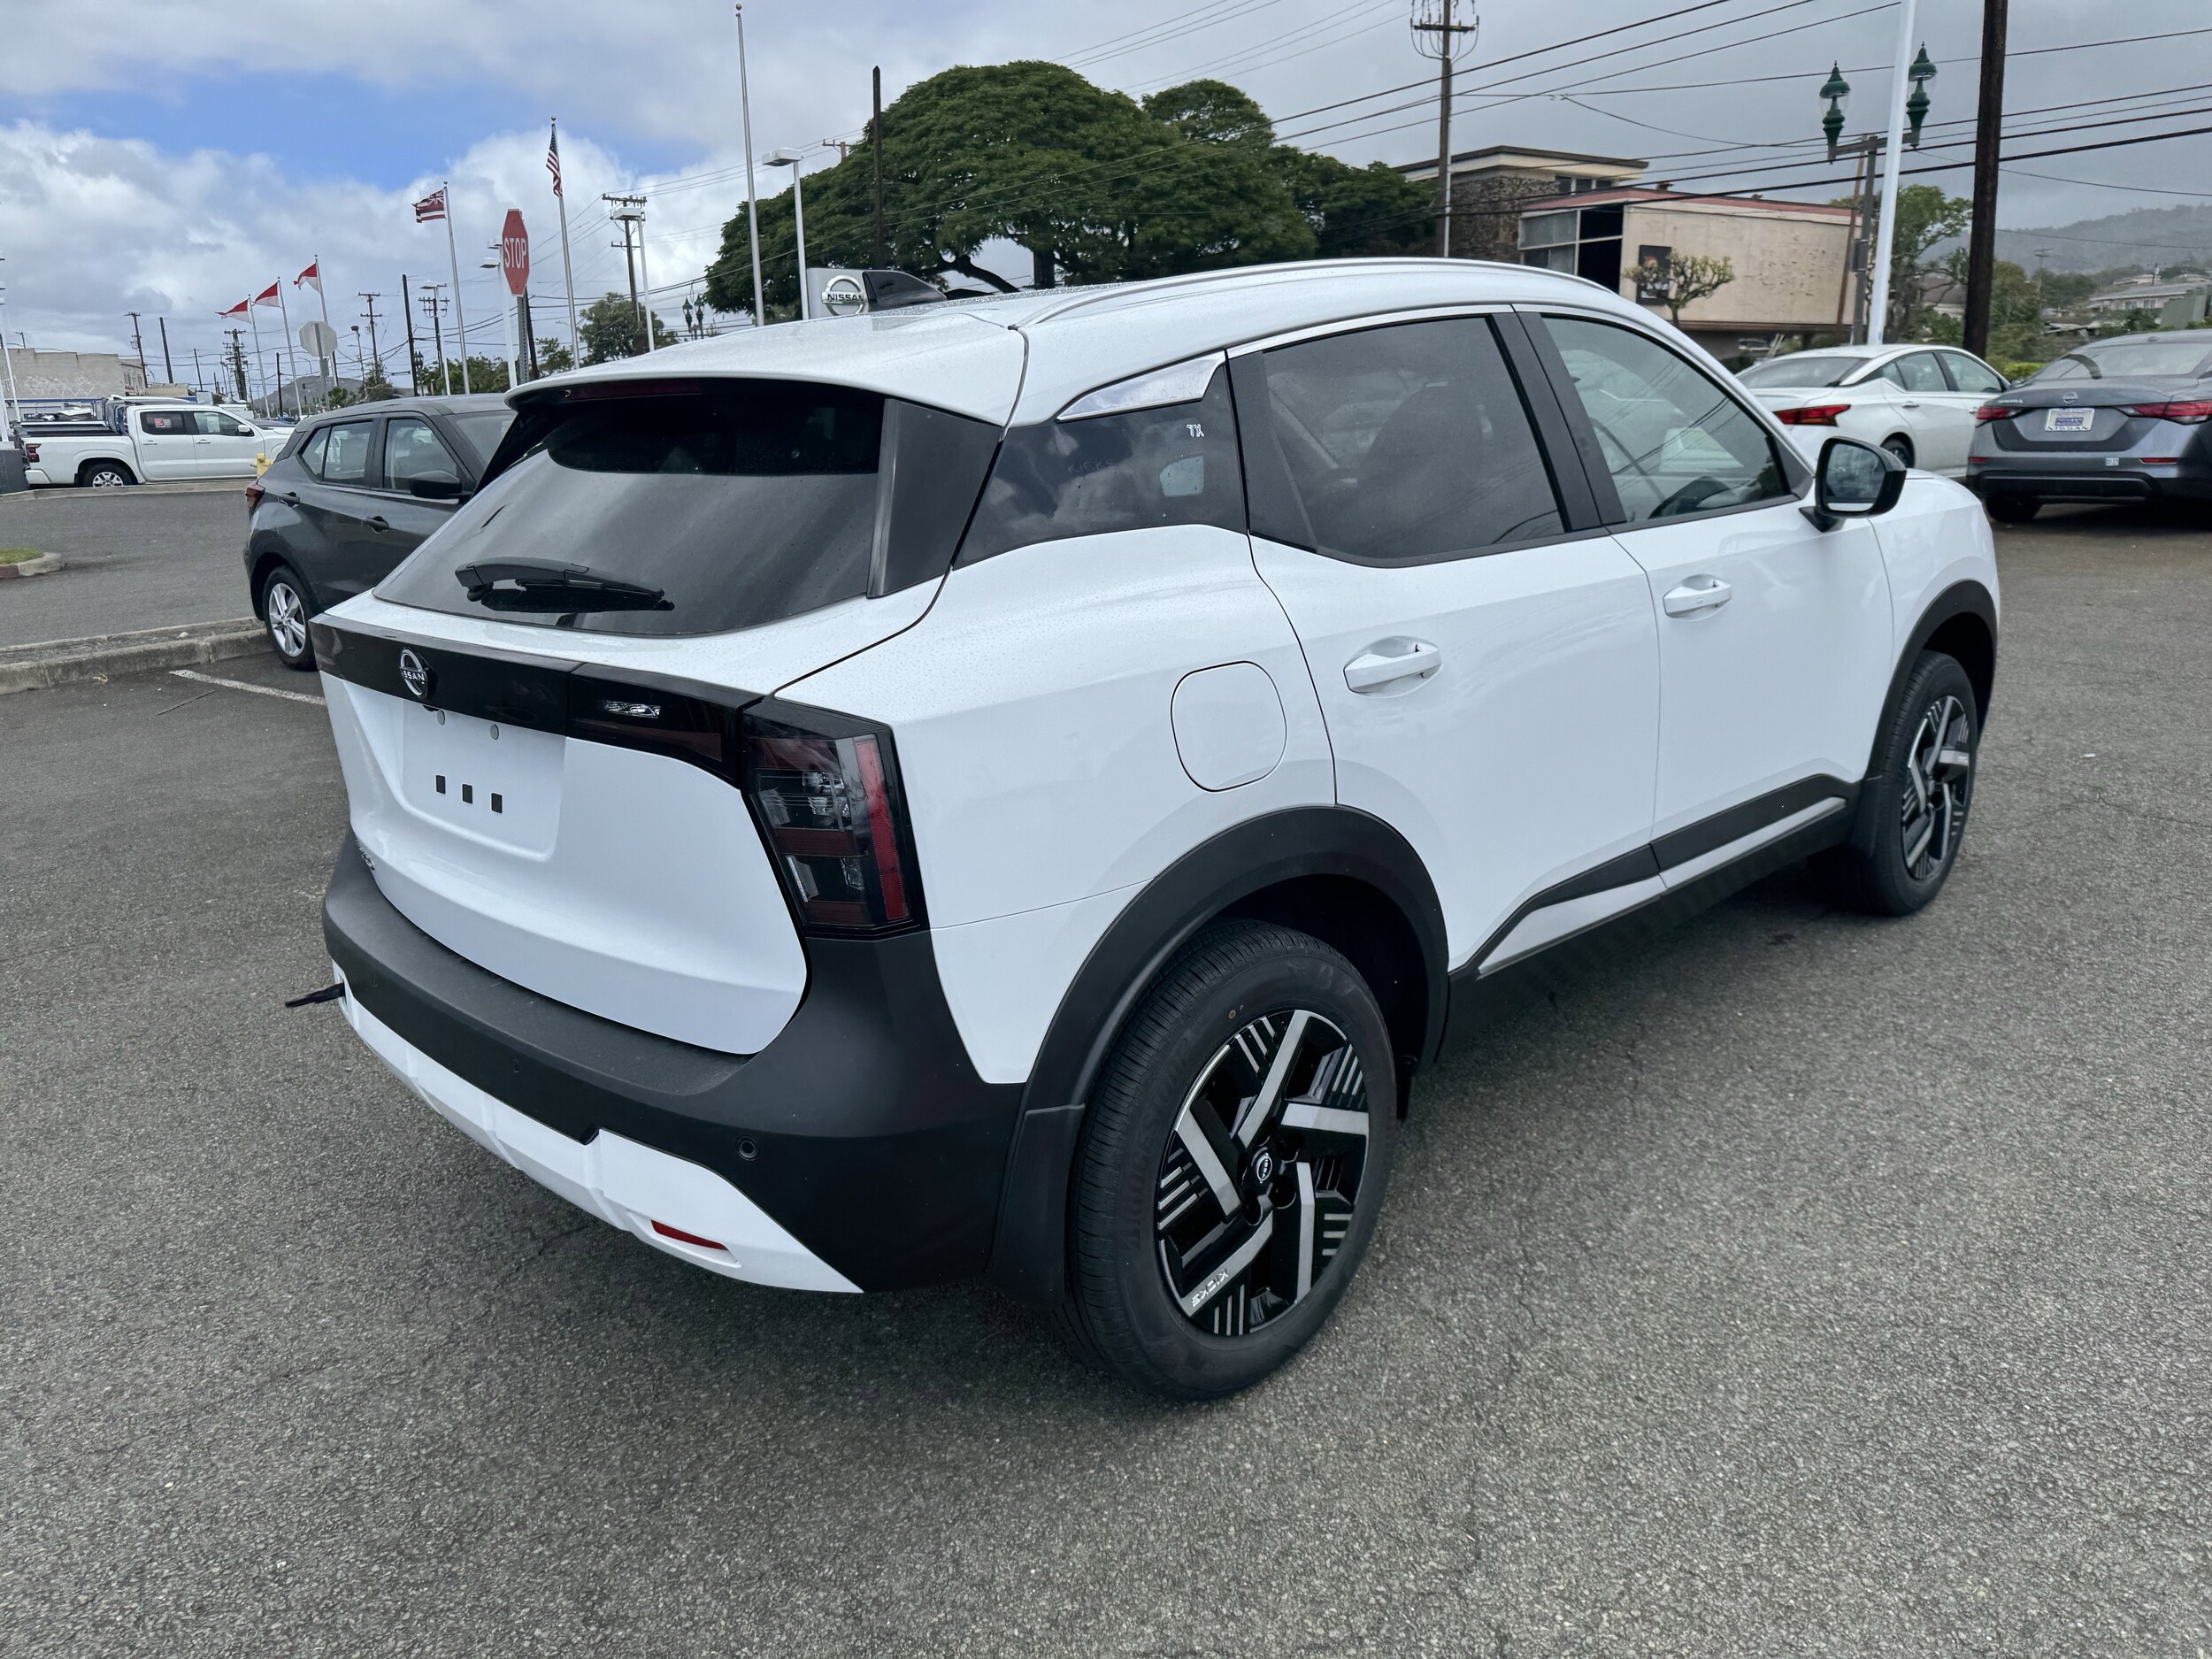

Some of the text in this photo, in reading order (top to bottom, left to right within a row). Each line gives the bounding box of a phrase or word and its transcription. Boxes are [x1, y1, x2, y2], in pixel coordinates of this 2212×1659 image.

[503, 237, 527, 269] STOP
[826, 294, 865, 303] NISSAN
[402, 670, 425, 681] SSAN
[1190, 1268, 1229, 1307] KICKS
